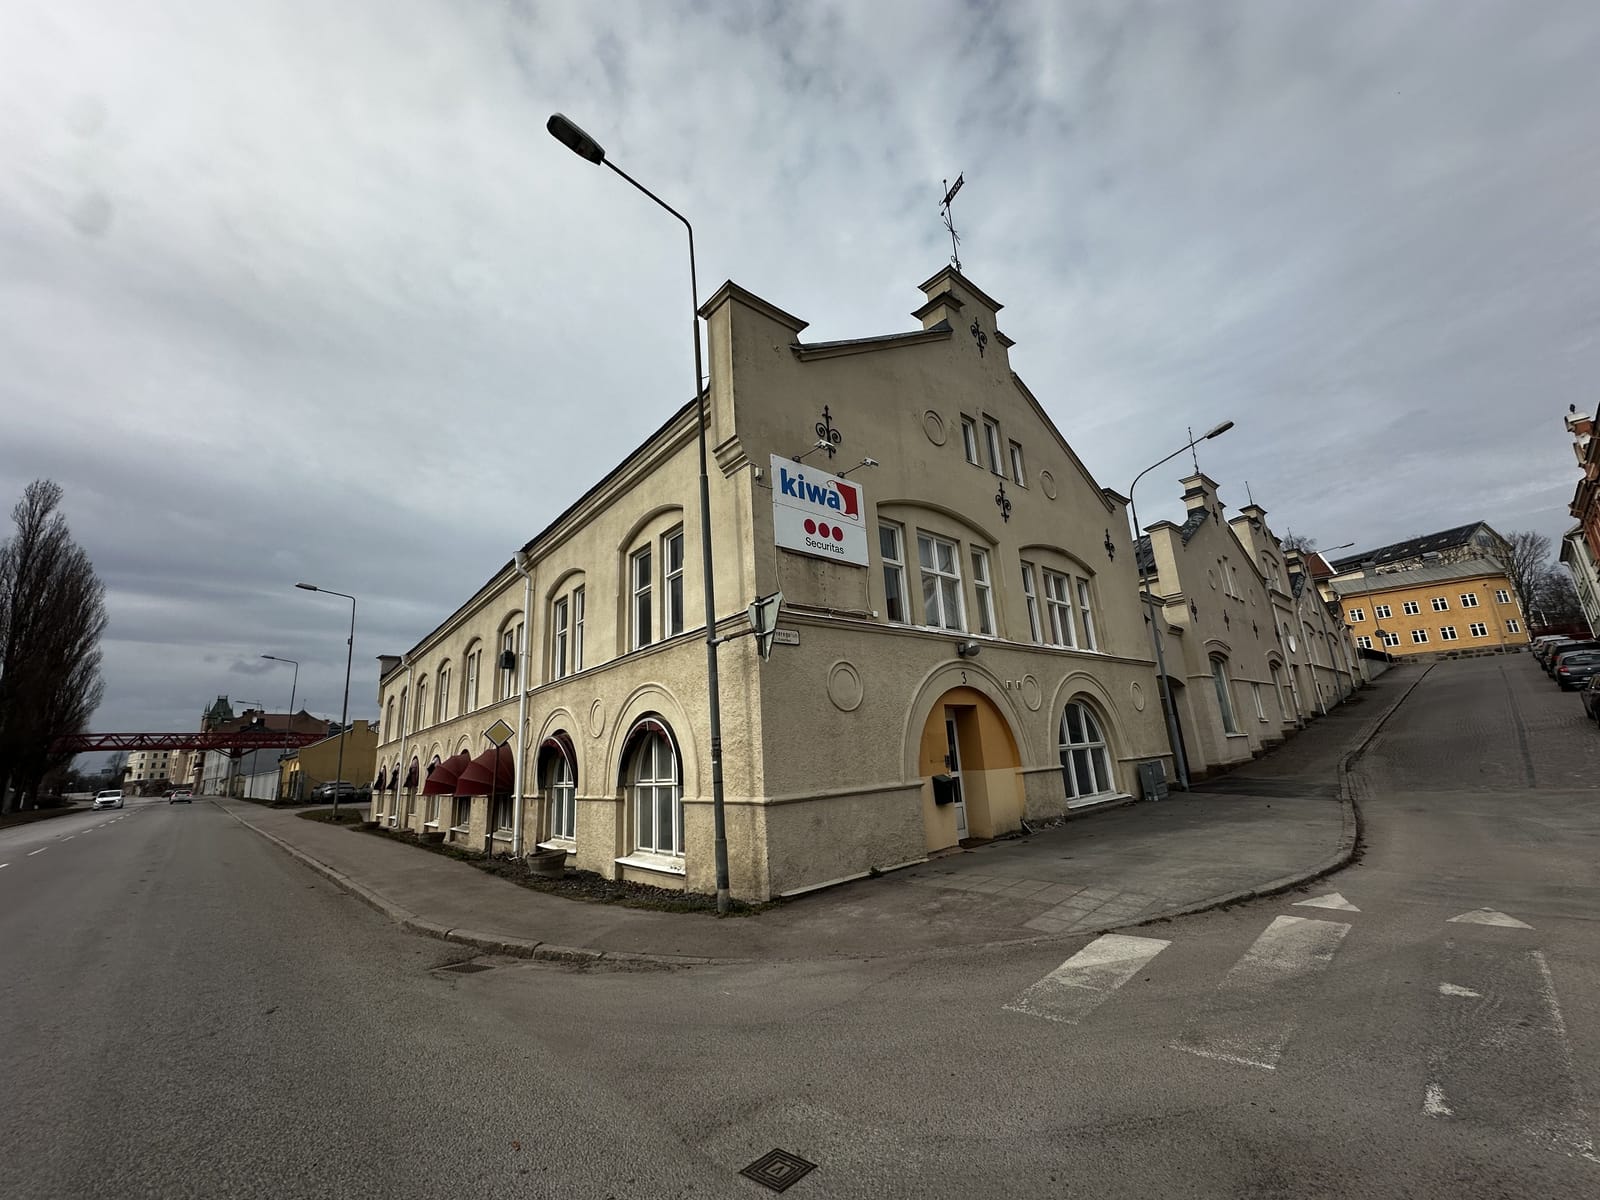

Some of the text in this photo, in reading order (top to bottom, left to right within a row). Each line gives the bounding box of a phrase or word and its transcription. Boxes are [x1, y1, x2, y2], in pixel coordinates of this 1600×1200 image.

[780, 468, 840, 510] kiwa
[805, 536, 845, 555] Securitas
[961, 671, 967, 684] 3
